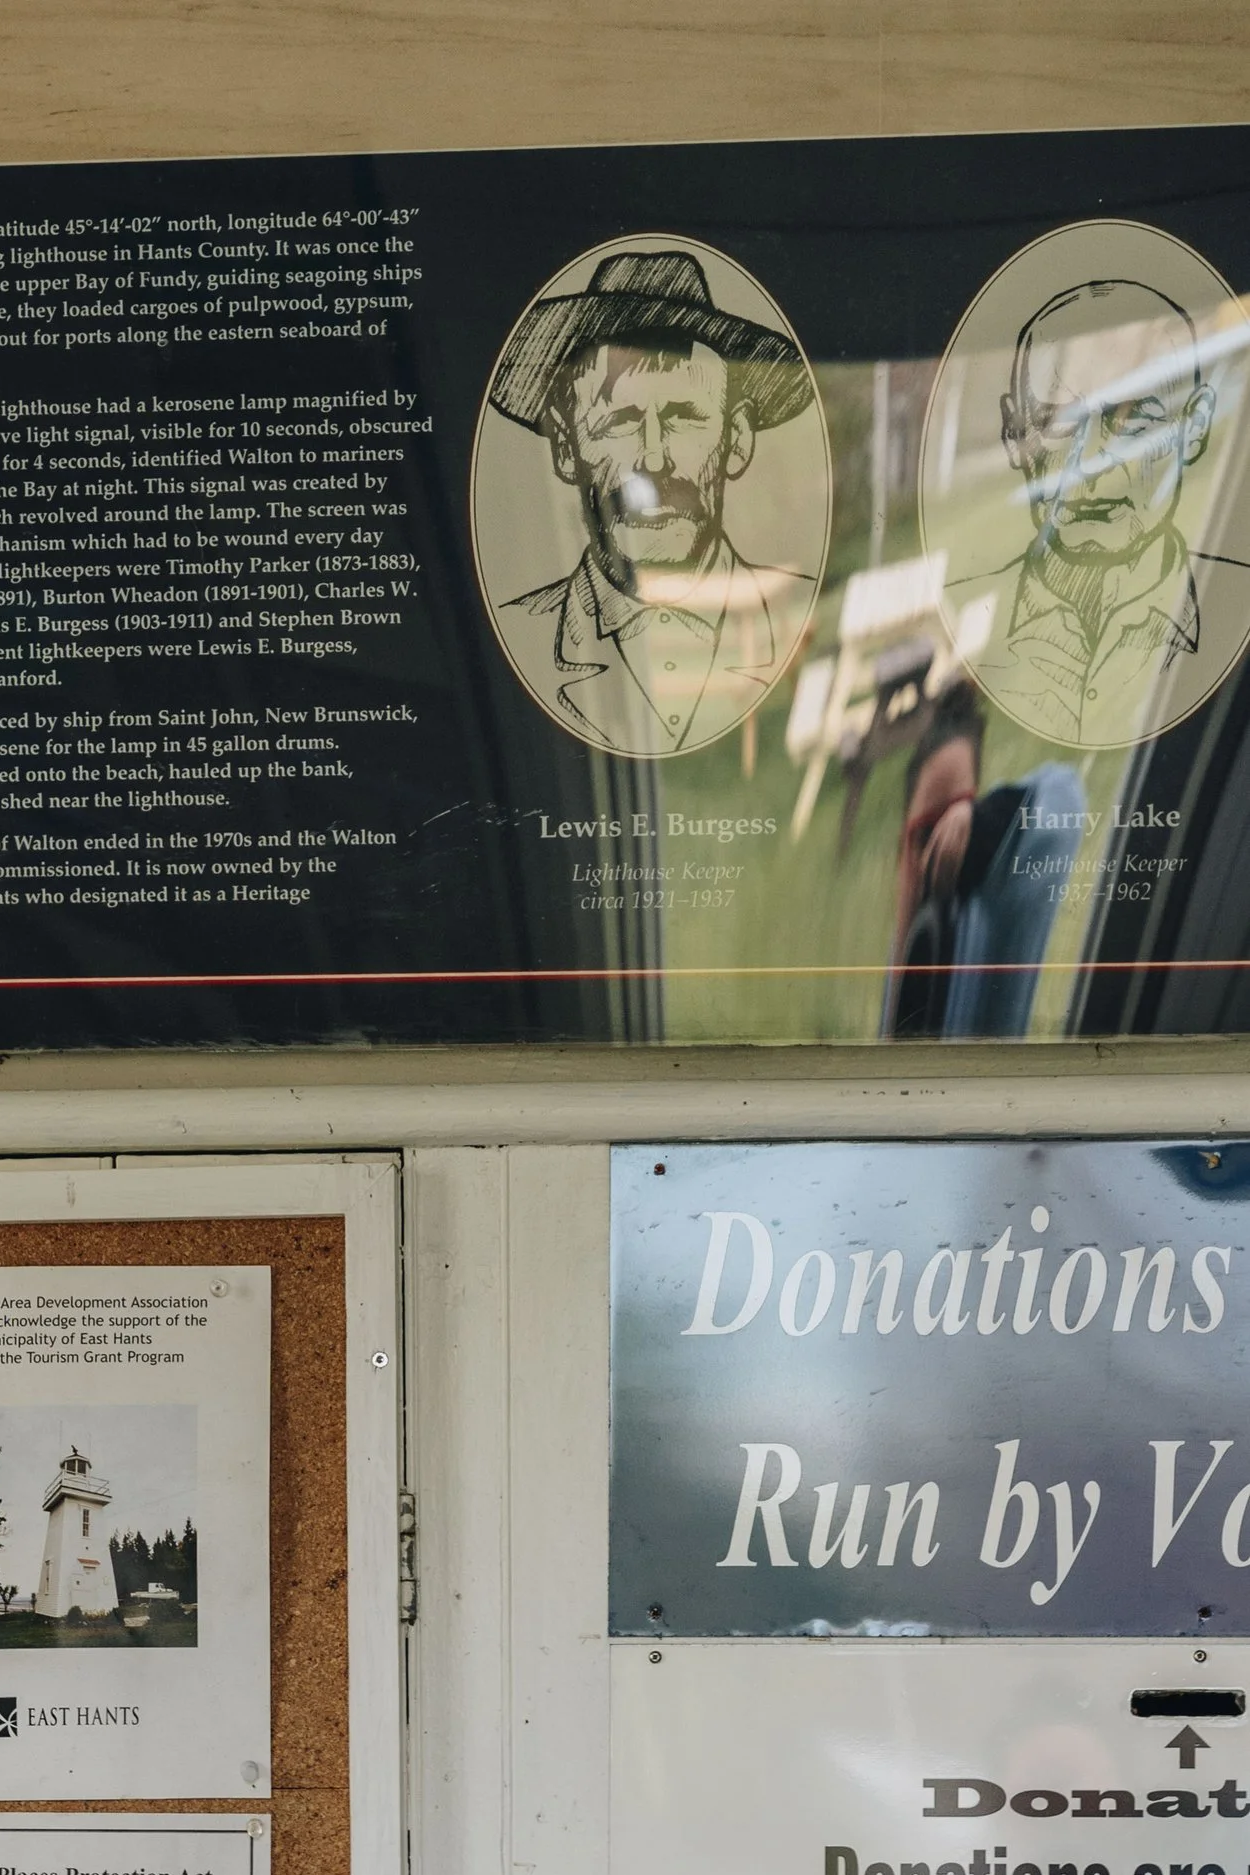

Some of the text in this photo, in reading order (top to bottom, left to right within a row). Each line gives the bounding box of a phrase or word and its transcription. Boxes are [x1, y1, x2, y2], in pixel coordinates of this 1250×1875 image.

[116, 563, 161, 576] were
[165, 557, 244, 579] Timothy
[249, 556, 311, 574] Parker
[315, 553, 421, 573] (1873-1883),
[42, 588, 106, 605] Burton
[110, 585, 199, 603] Wheadon
[204, 583, 309, 603] (1891-1901),
[314, 581, 385, 599] Charles
[390, 580, 418, 597] W.
[34, 711, 58, 734] by
[63, 711, 103, 732] ship
[108, 710, 152, 727] from
[158, 708, 206, 726] Saint
[210, 707, 259, 729] John,
[265, 707, 308, 724] New
[313, 704, 418, 724] Brunswick,
[540, 813, 777, 843] Lewis E. Burgess
[1020, 804, 1181, 836] Harry Lake
[571, 862, 744, 887] Lighthouse Keeper
[1012, 854, 1188, 879] Lighthouse Keeper
[580, 891, 624, 910] circa
[680, 1206, 1232, 1337] Donations
[0, 1297, 32, 1310] Area
[36, 1295, 127, 1315] Development
[130, 1295, 208, 1309] Association
[80, 1314, 105, 1329] the
[108, 1315, 161, 1330] support
[165, 1313, 180, 1327] of
[184, 1313, 208, 1327] the
[61, 1332, 76, 1345] of
[80, 1332, 109, 1345] East
[113, 1332, 153, 1345] Hants
[0, 1351, 23, 1365] the
[26, 1351, 79, 1364] Tourism
[83, 1350, 123, 1363] Grant
[127, 1350, 184, 1366] Program
[716, 1443, 941, 1569] Run
[979, 1440, 1101, 1606] by
[28, 1706, 140, 1727] EAST HANTS
[922, 1778, 1250, 1819] Donat
